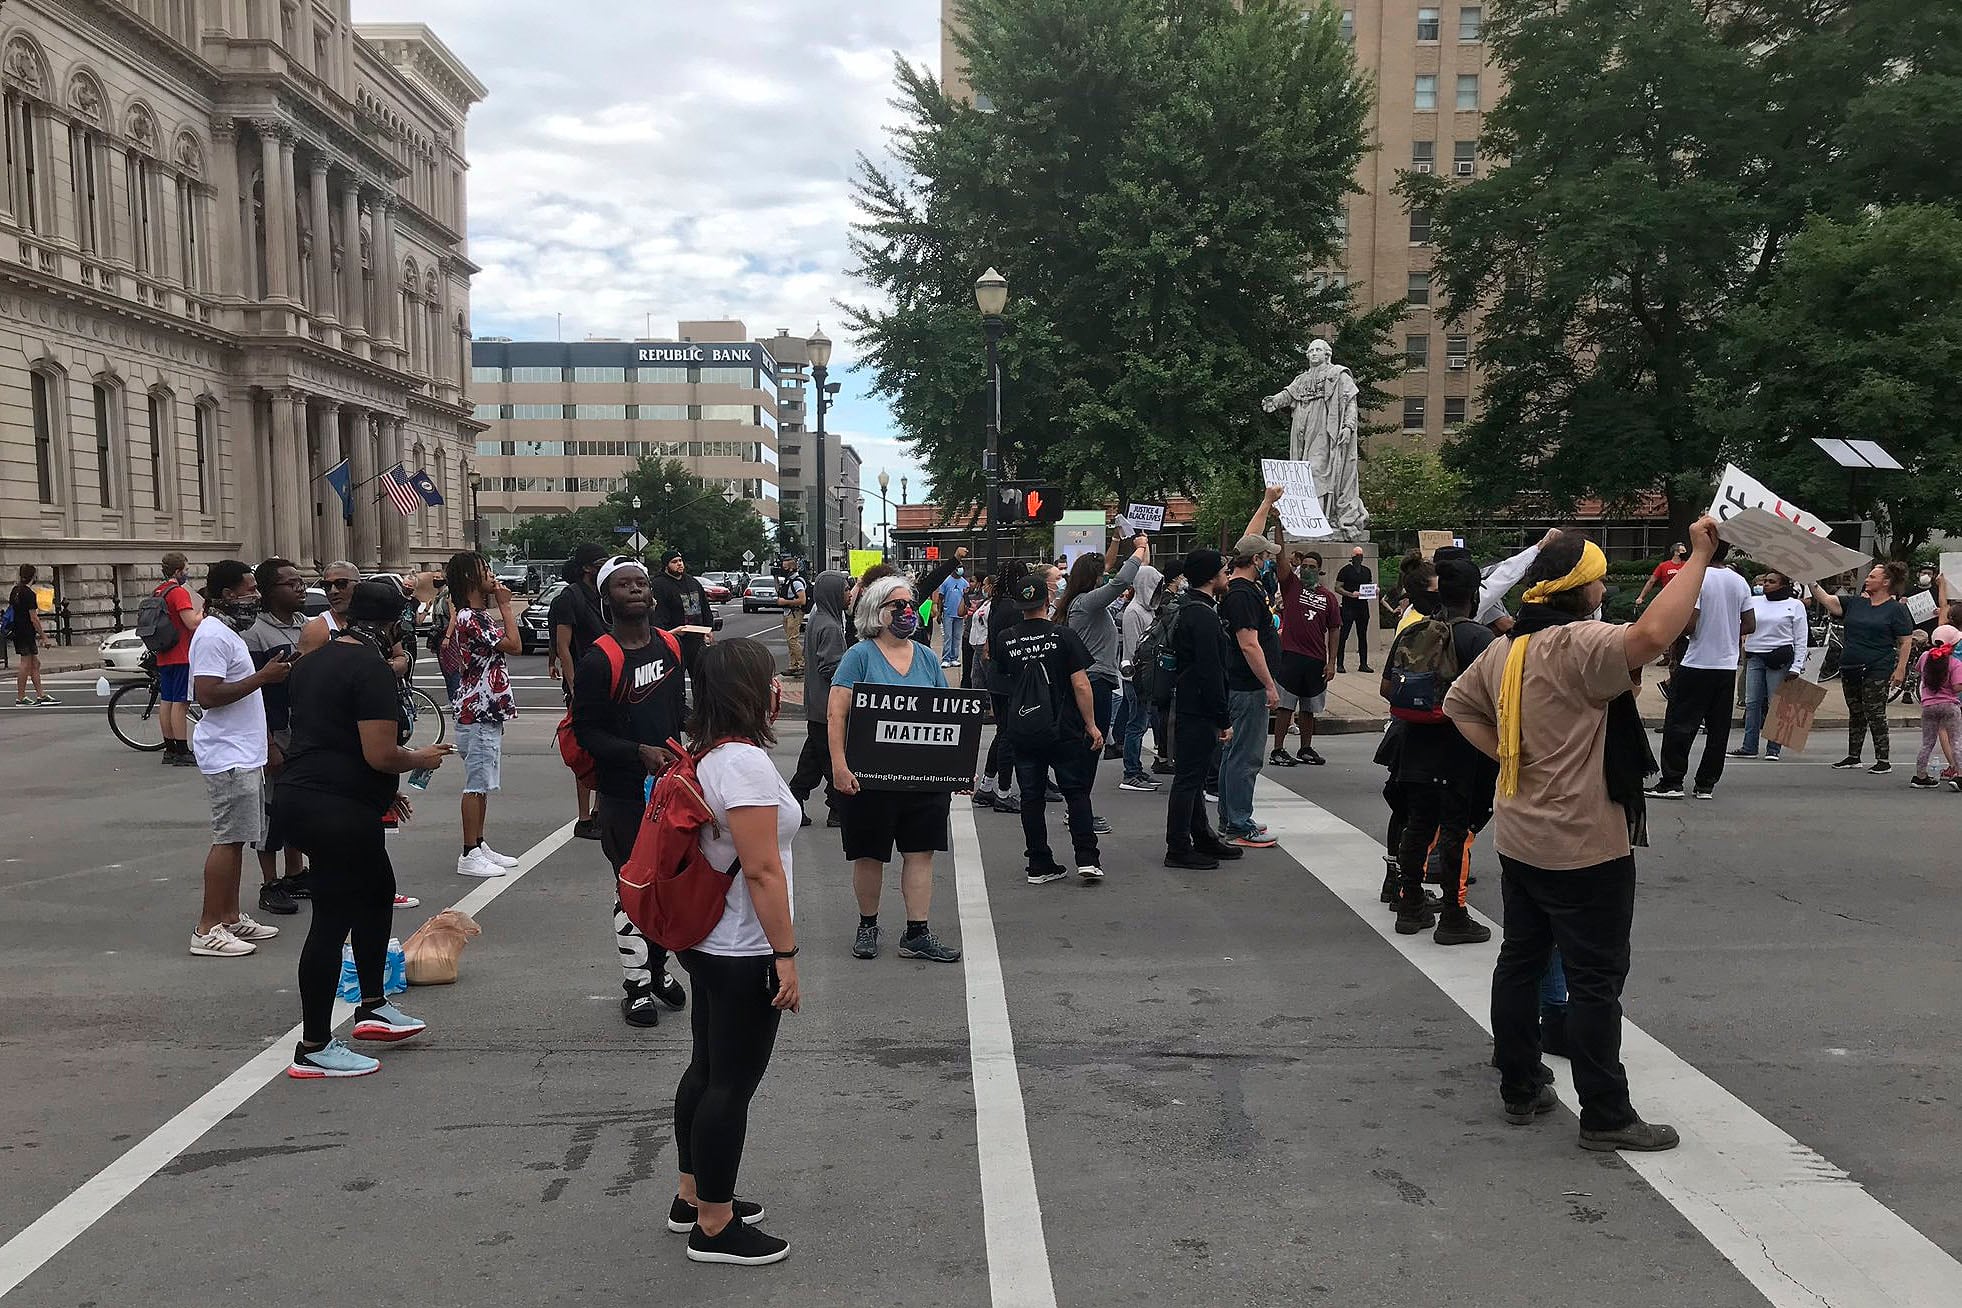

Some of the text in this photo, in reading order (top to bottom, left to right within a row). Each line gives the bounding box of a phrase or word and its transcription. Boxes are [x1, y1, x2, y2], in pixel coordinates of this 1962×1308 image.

[639, 349, 752, 361] REPUBLIC BANK
[1263, 461, 1311, 484] PROPERTY
[1129, 511, 1146, 519] BLACK
[1134, 506, 1154, 514] JUSTICE
[1301, 517, 1323, 529] NOT
[634, 659, 665, 689] NIKE
[855, 692, 981, 714] BLACK LIVES
[884, 724, 954, 742] MATTER
[854, 771, 970, 782] ShowingUpForRacialJustice.org
